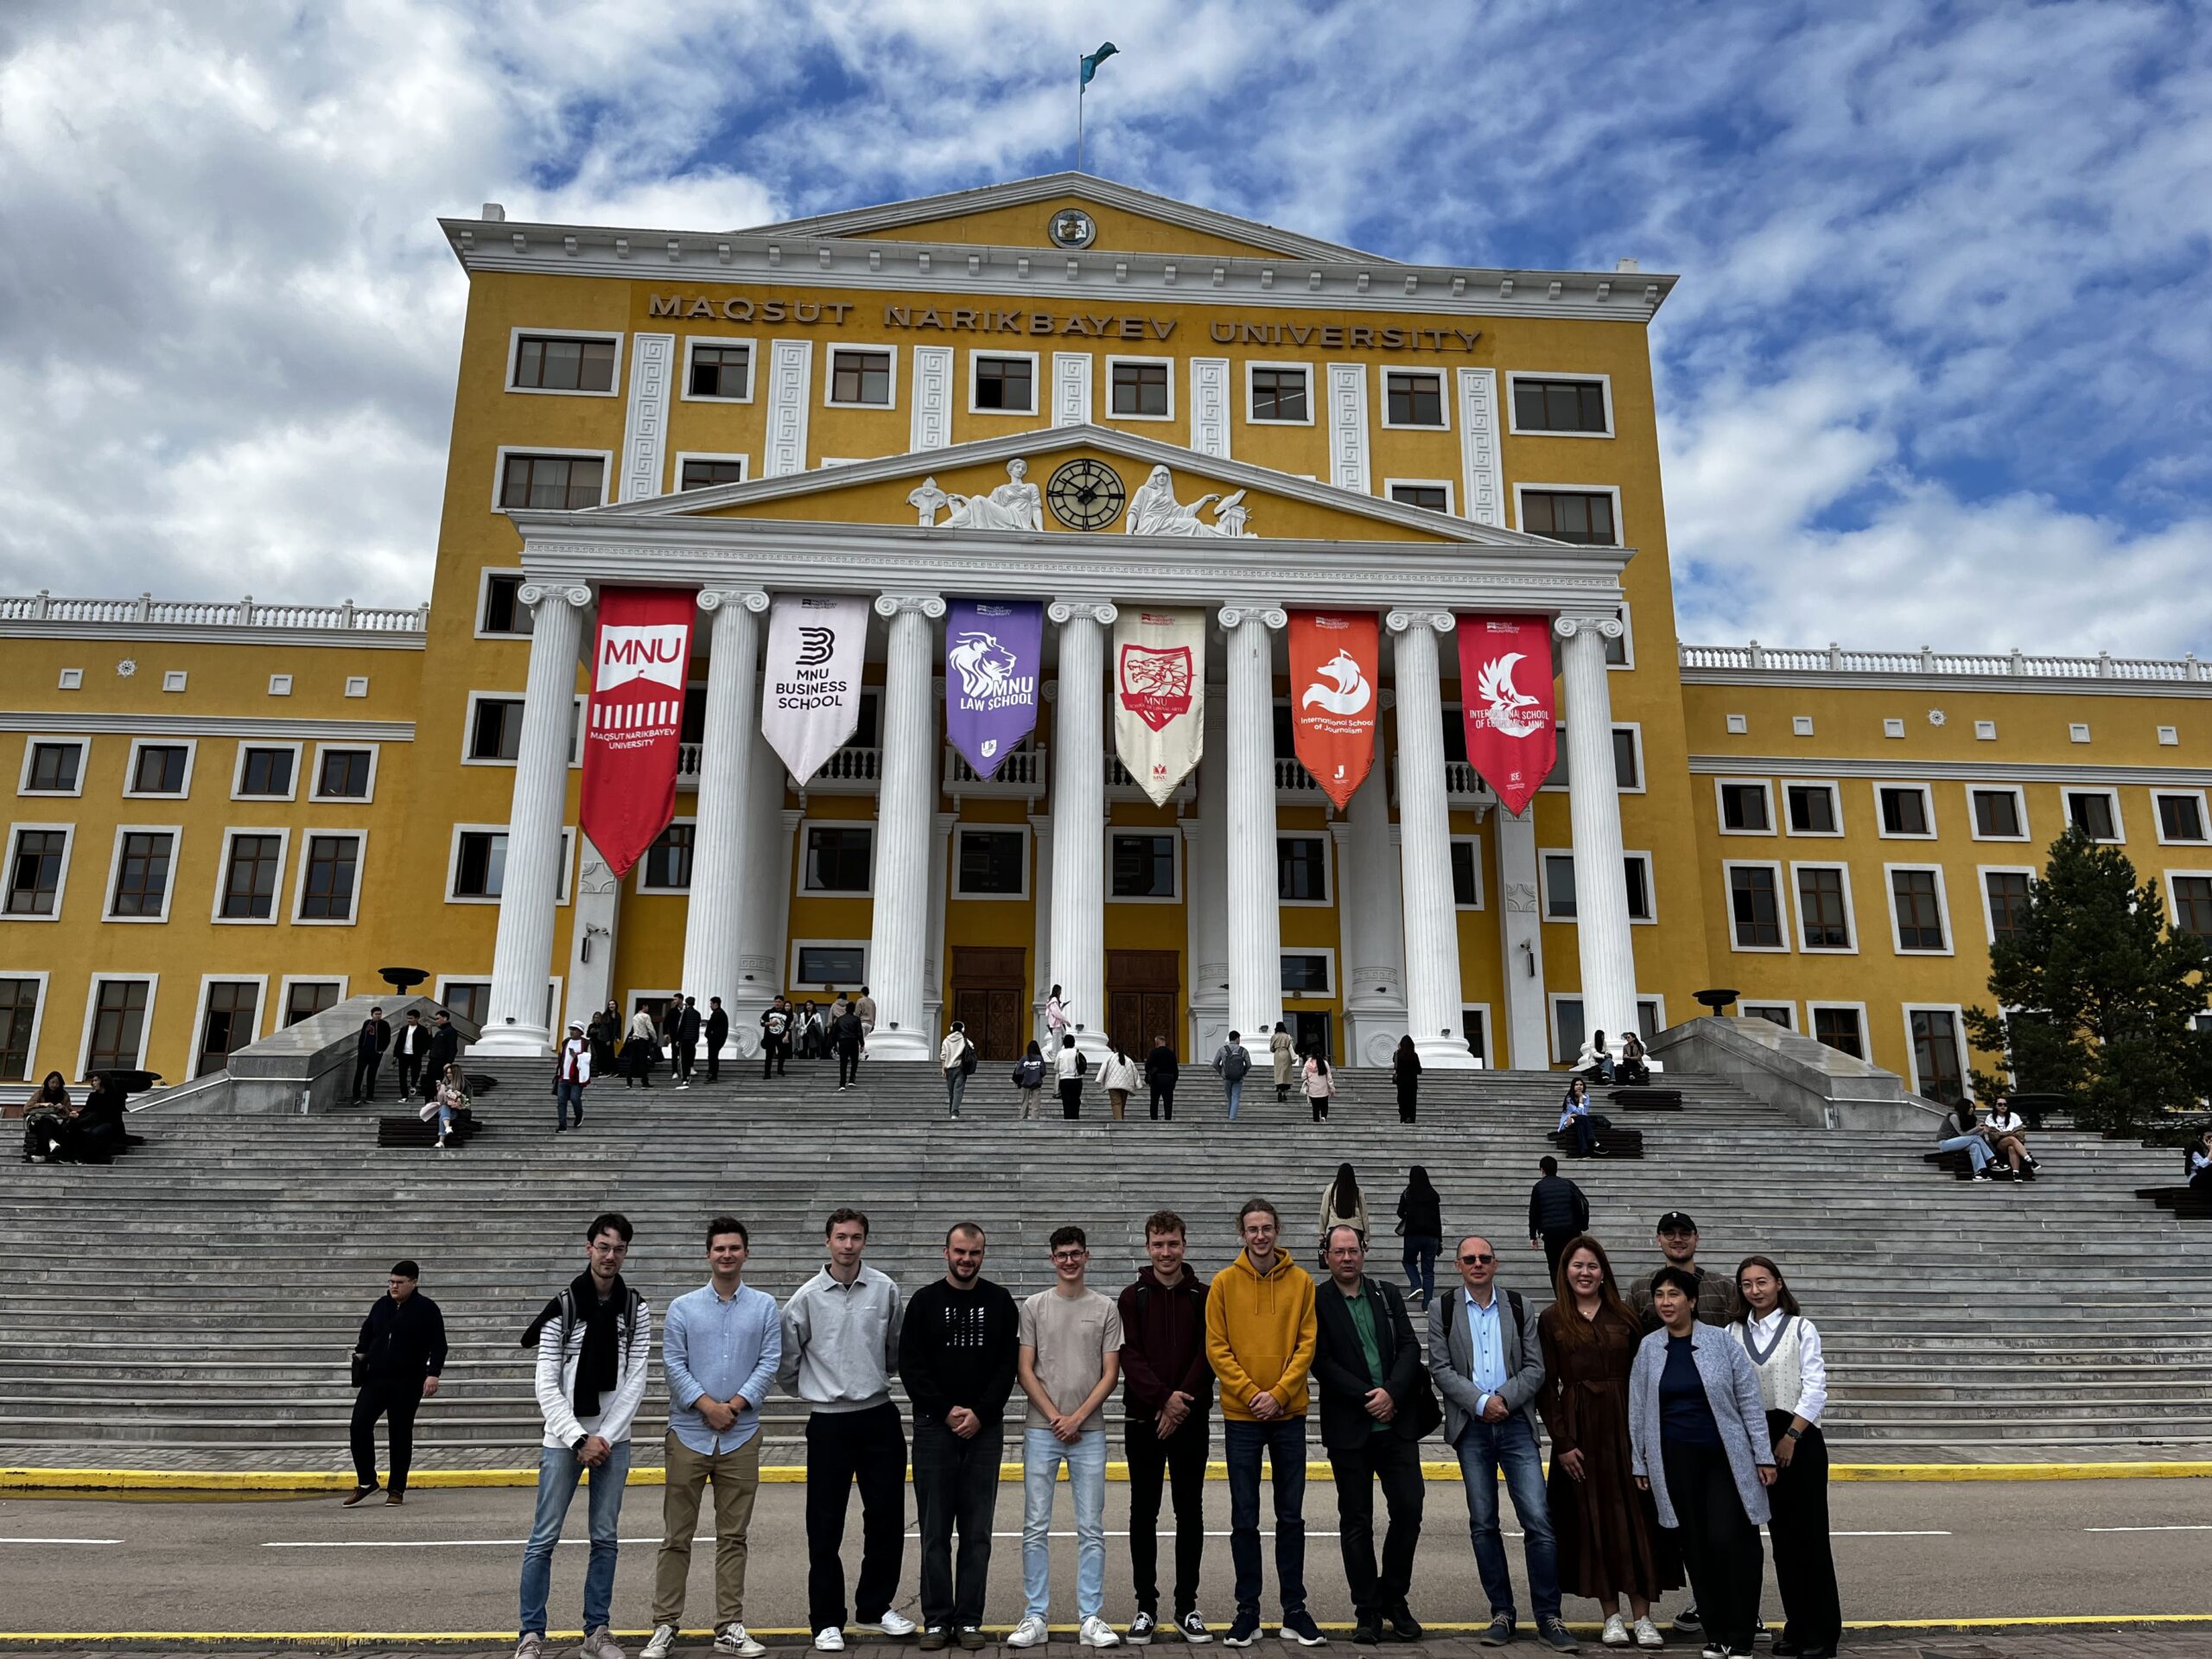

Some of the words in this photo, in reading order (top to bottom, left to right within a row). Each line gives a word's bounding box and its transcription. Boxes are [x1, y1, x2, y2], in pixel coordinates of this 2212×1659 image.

[650, 294, 854, 326] MAQSUT
[884, 304, 1178, 340] NARIKBAYEV
[1210, 319, 1481, 353] UNIVERSITY
[604, 638, 681, 664] MNU
[797, 668, 829, 681] MNU
[776, 681, 847, 696] BUSINESS
[993, 677, 1033, 697] MNU
[779, 695, 842, 710] SCHOOL
[960, 697, 985, 711] LAW
[988, 693, 1033, 710] SCHOOL
[1144, 696, 1167, 706] MNU
[1300, 717, 1347, 726] International
[1522, 710, 1549, 720] SCHOOL
[1476, 719, 1484, 728] OF
[590, 731, 624, 741] MAQSUT
[626, 728, 676, 740] NARIKBAYEV
[608, 739, 655, 750] UNIVERSITY
